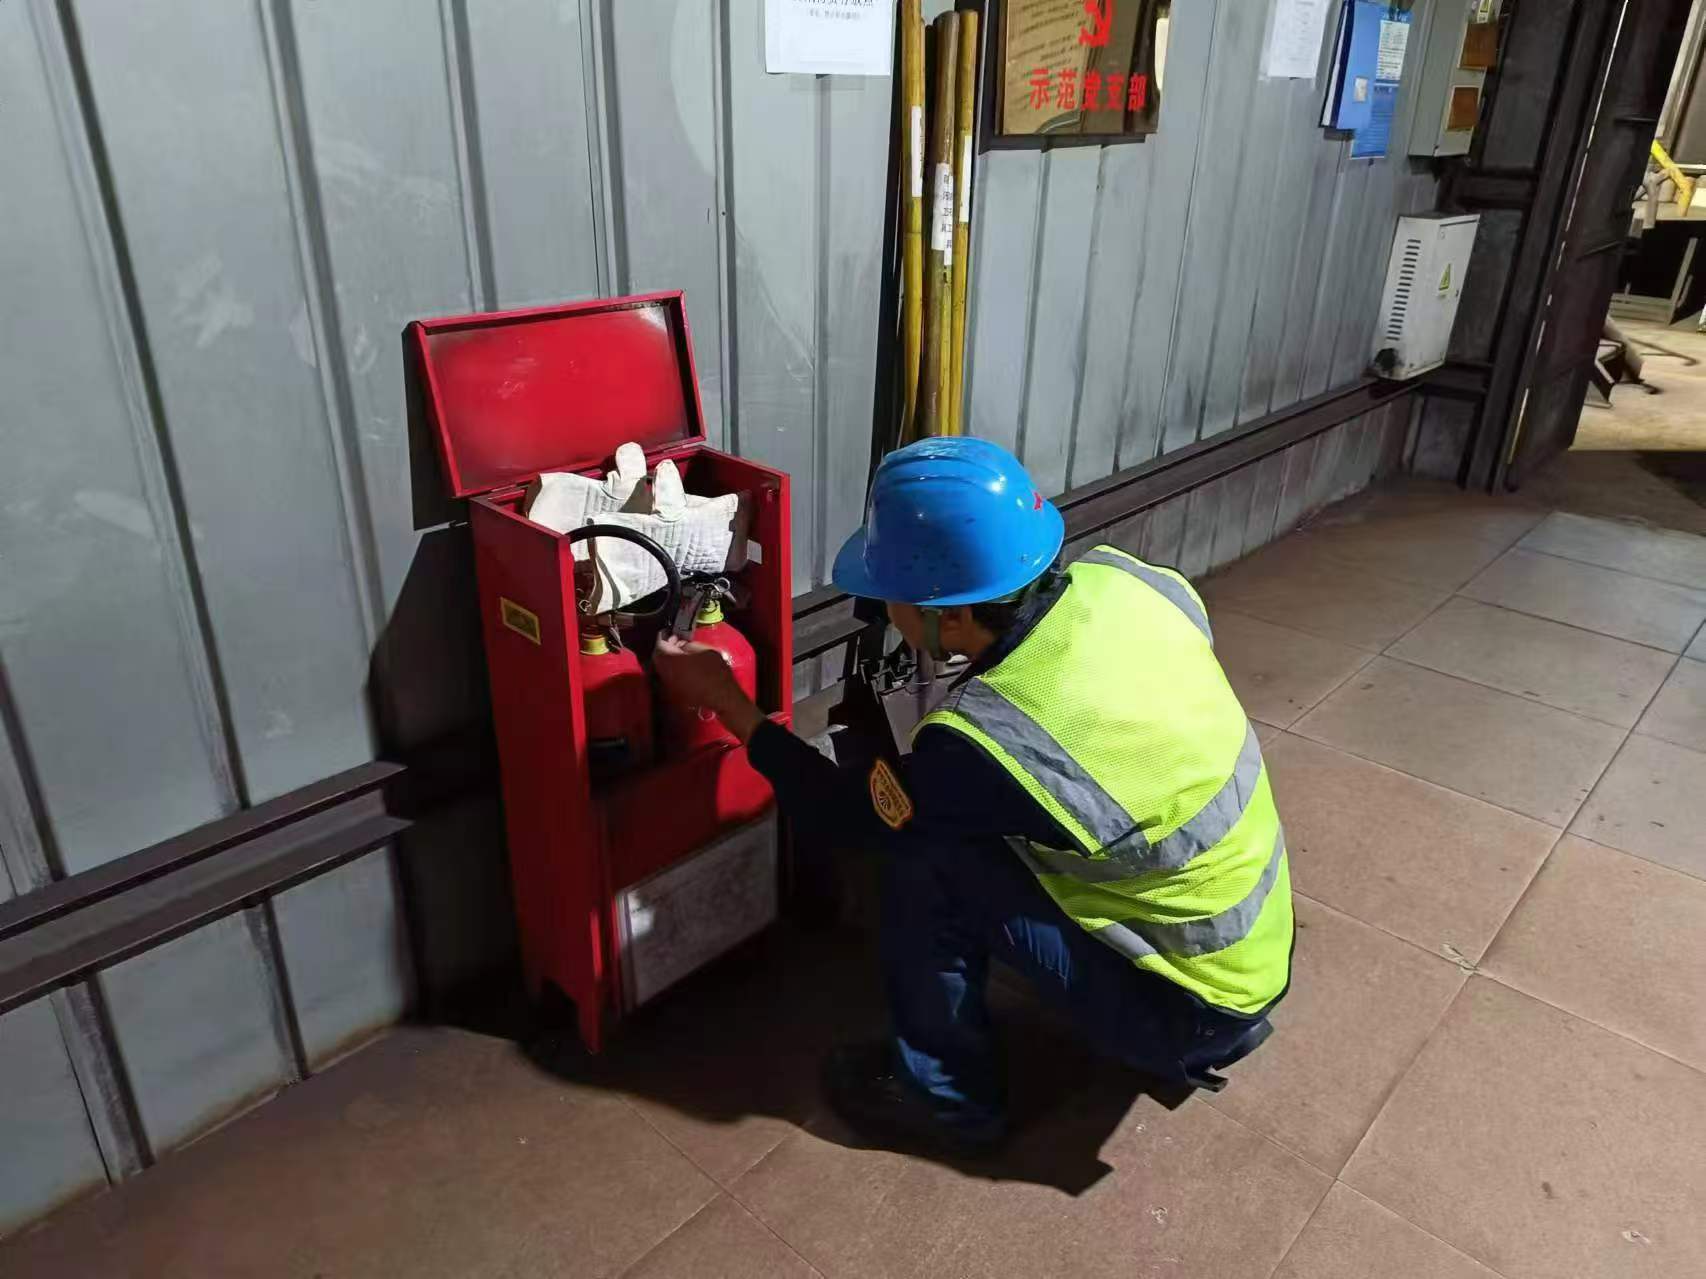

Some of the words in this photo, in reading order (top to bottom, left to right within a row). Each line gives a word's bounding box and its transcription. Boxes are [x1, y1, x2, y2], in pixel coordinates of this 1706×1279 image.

[1029, 69, 1147, 111] 示范党支部
